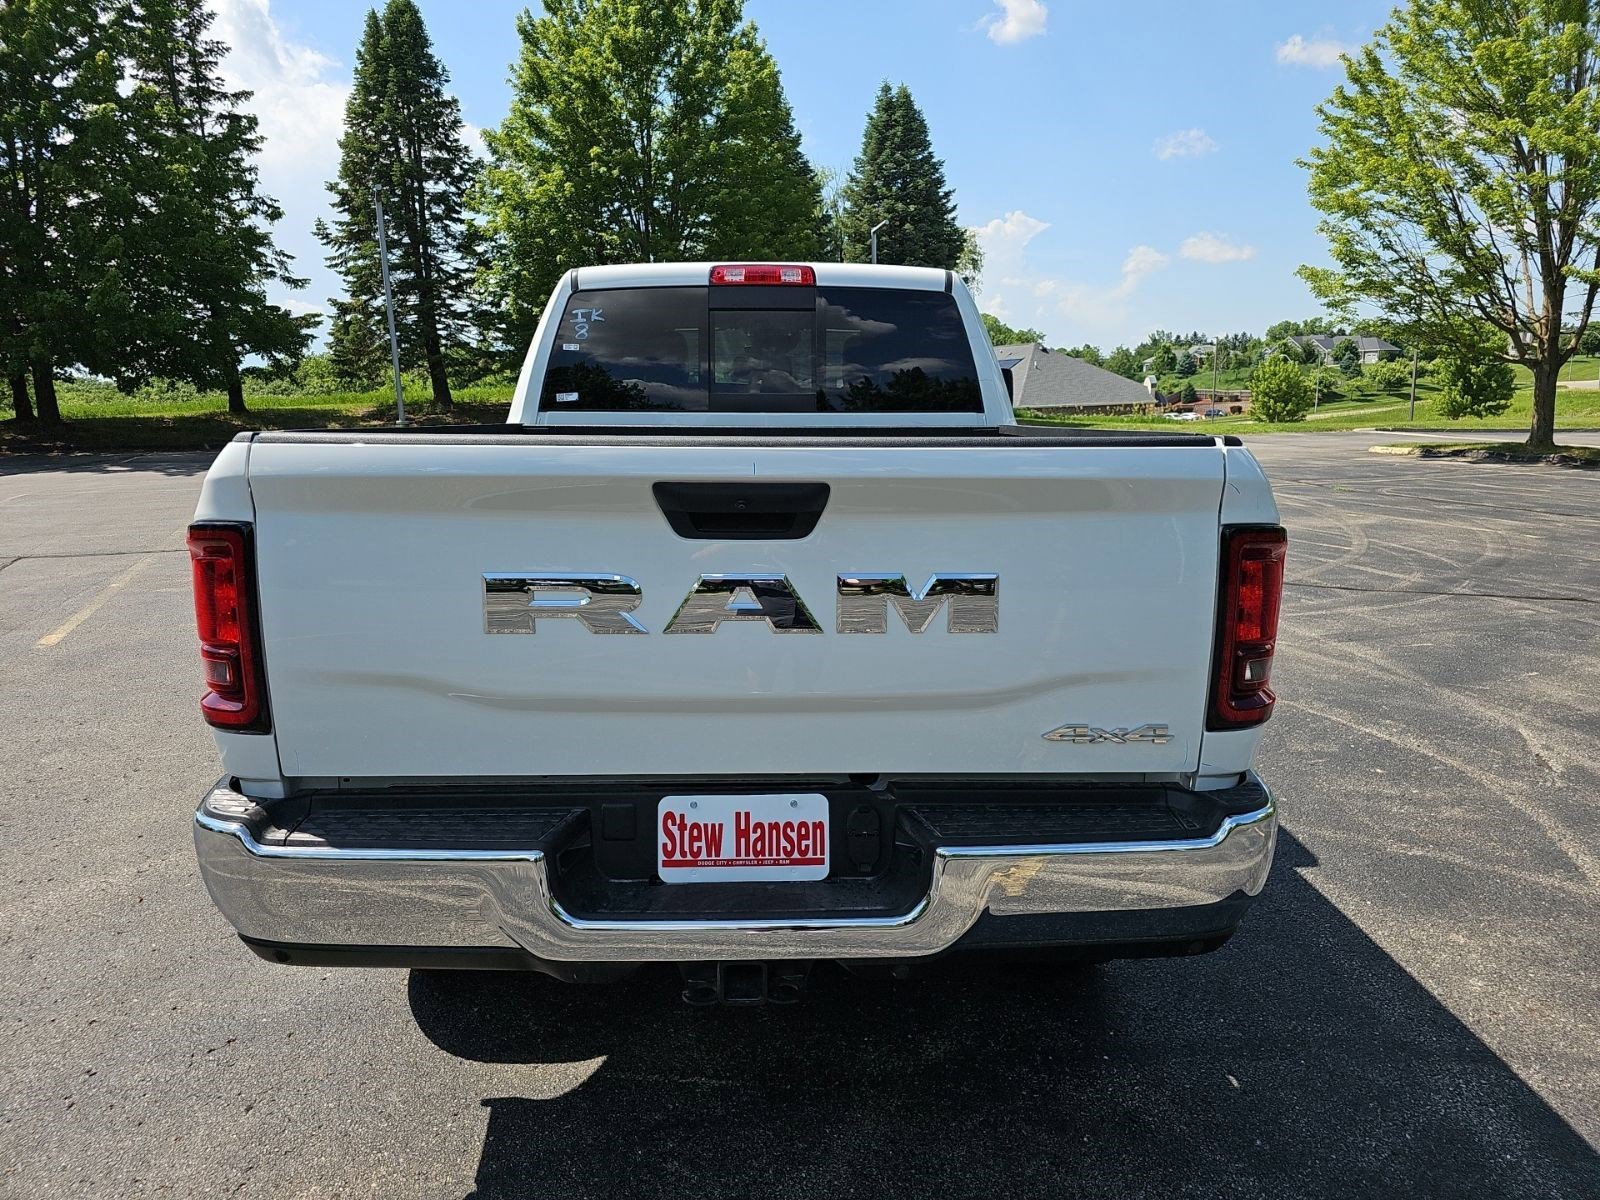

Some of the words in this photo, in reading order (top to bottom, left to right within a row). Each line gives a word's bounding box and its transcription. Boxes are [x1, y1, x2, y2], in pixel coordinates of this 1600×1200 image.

[575, 323, 589, 340] 8
[481, 572, 1000, 635] RAM
[662, 811, 724, 859] Stew
[735, 811, 825, 858] Hansen
